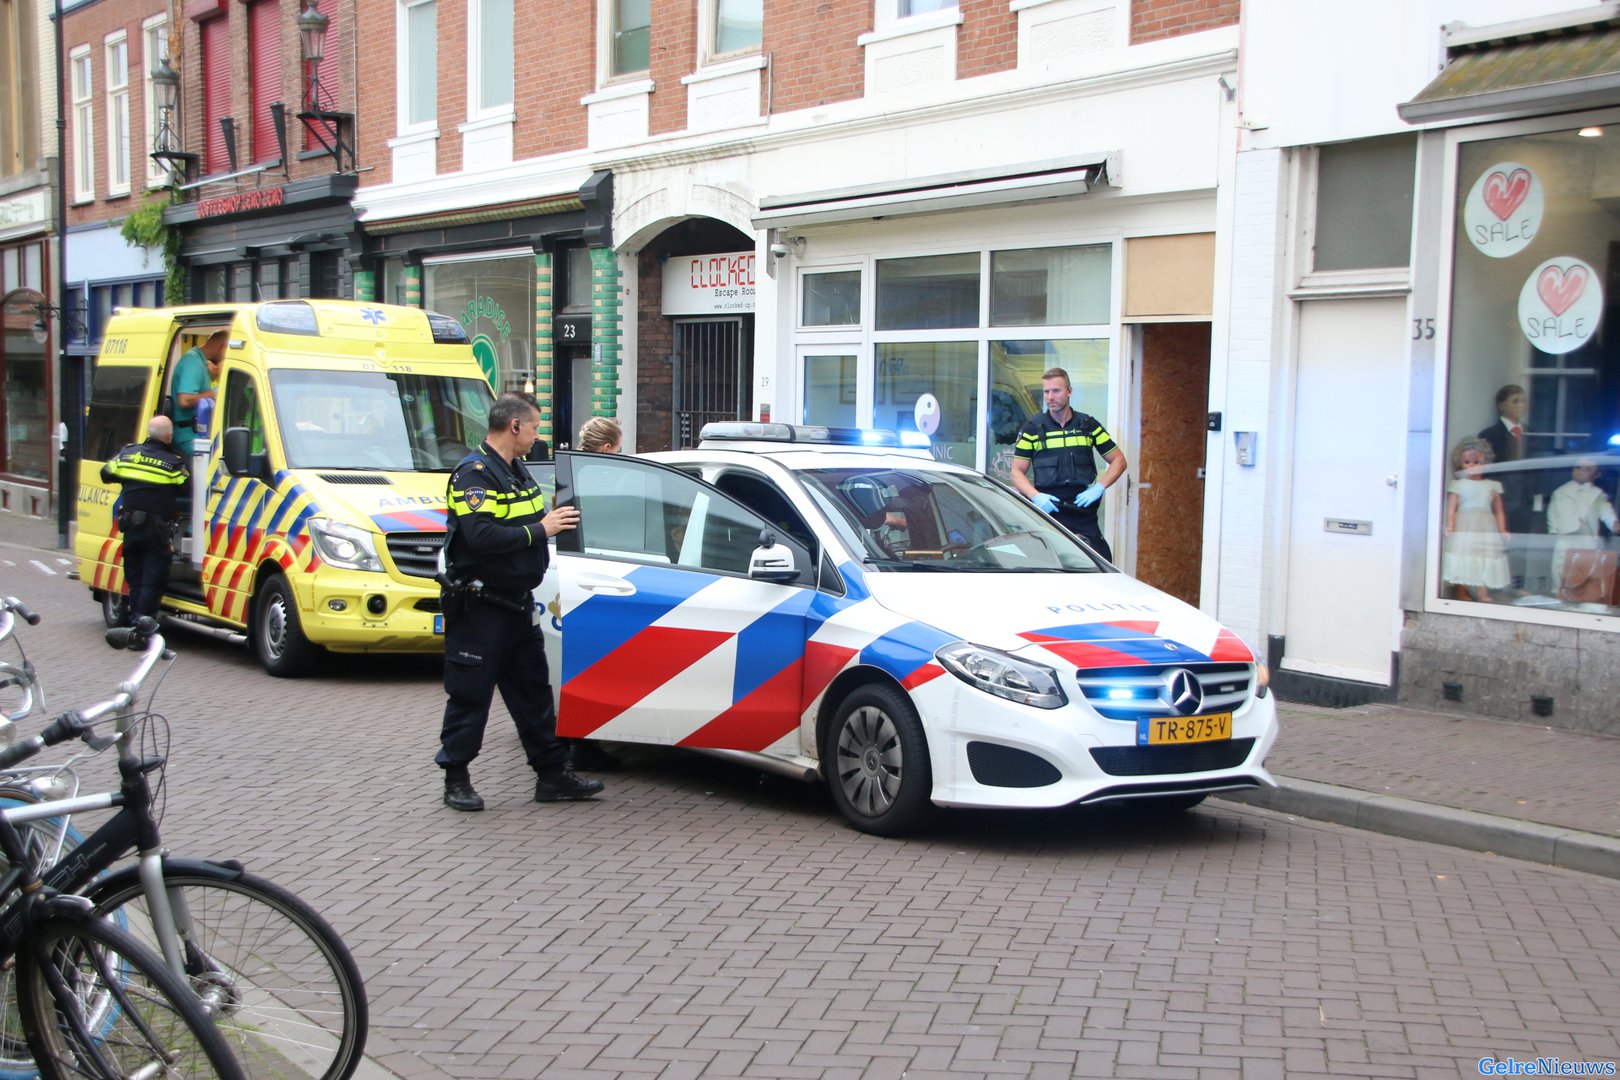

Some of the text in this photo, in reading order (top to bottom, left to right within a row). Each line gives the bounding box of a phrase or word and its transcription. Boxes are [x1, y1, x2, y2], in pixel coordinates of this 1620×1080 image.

[1475, 219, 1534, 245] SALE
[714, 288, 738, 298] Escape
[460, 296, 511, 343] ARADISE
[1527, 317, 1589, 339] SALE
[564, 324, 576, 338] 23
[1412, 318, 1435, 341] 35
[105, 338, 128, 354] 07118
[379, 496, 446, 507] AMBU
[1046, 603, 1159, 615] POLITIE
[1156, 717, 1226, 740] TR-875-V
